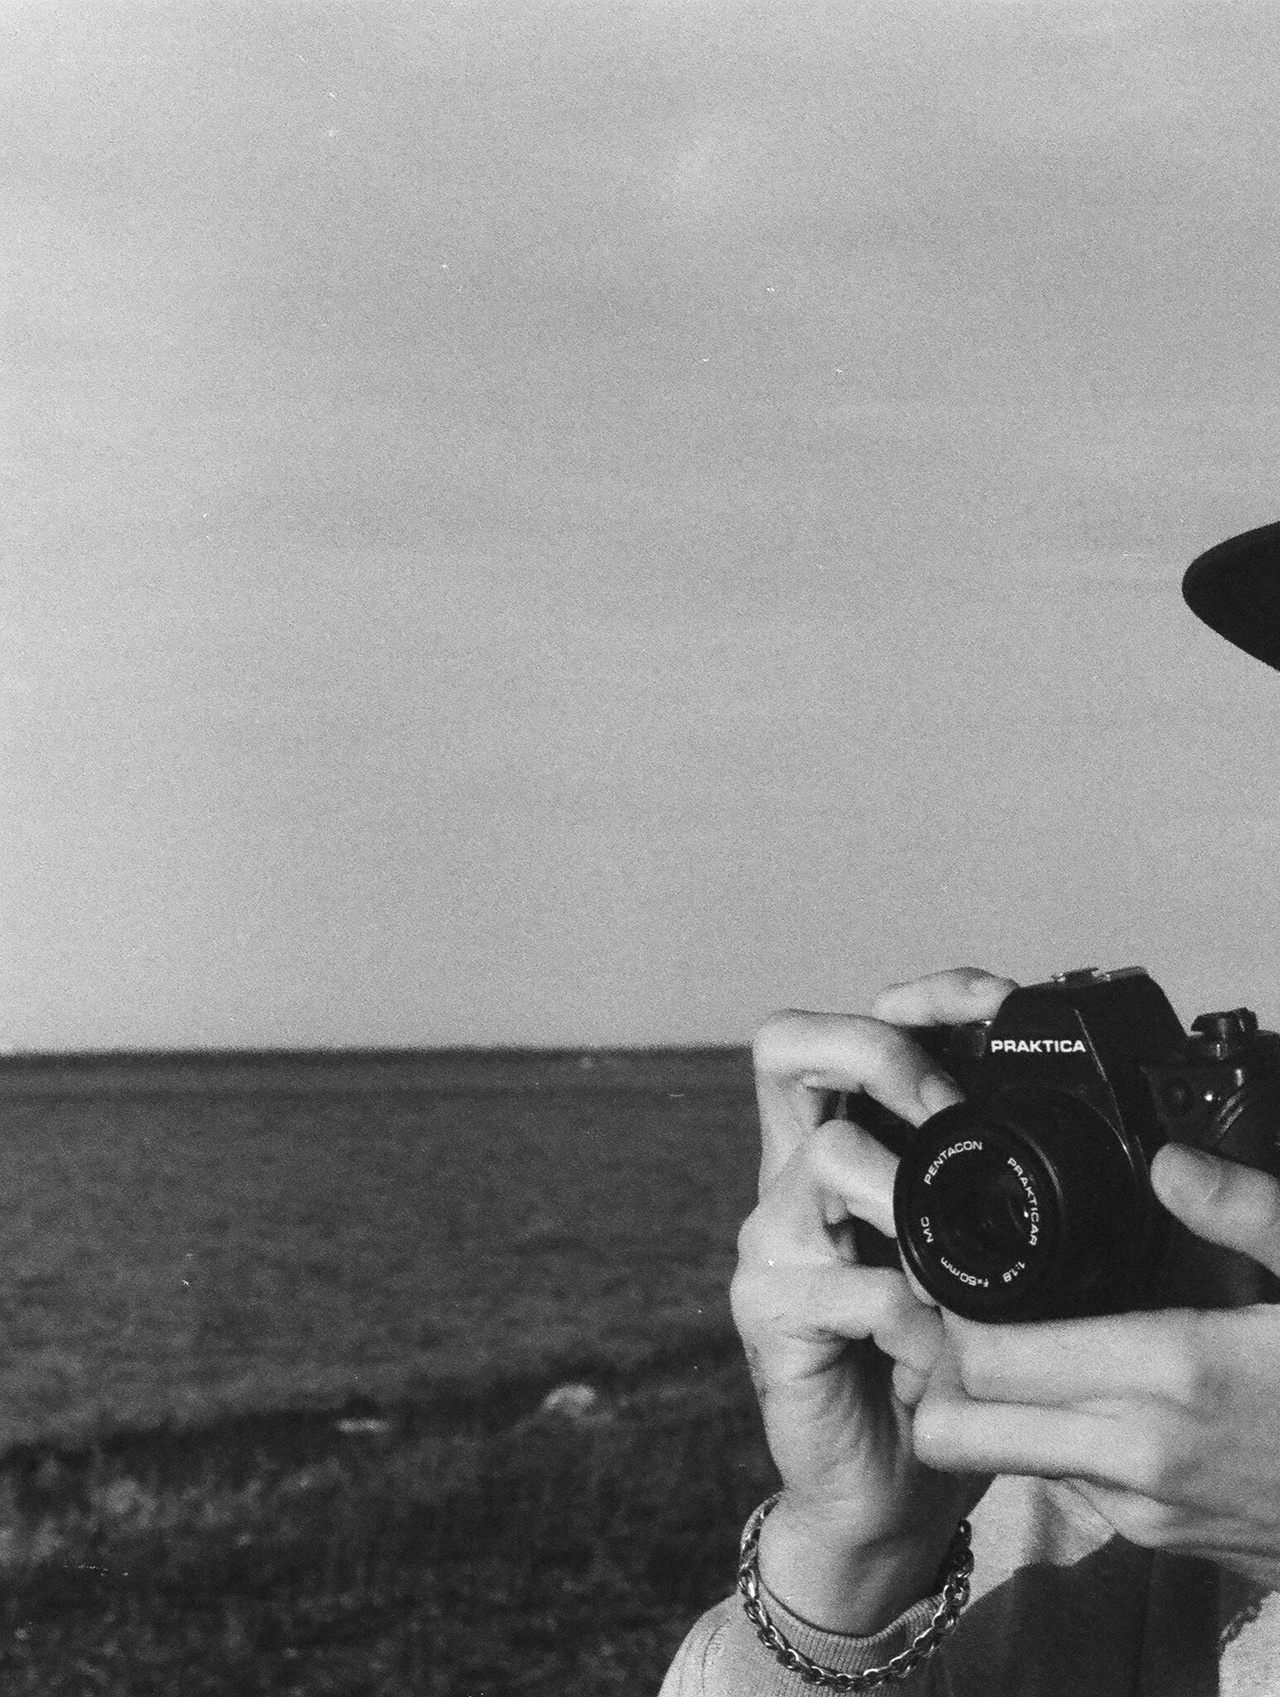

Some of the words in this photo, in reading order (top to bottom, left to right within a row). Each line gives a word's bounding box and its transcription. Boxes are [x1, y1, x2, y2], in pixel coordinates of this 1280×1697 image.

[990, 1039, 1087, 1053] PRAKTICA
[923, 1140, 984, 1186] PENTACON
[1007, 1156, 1040, 1246] PRAKTICAR
[920, 1216, 934, 1243] MC
